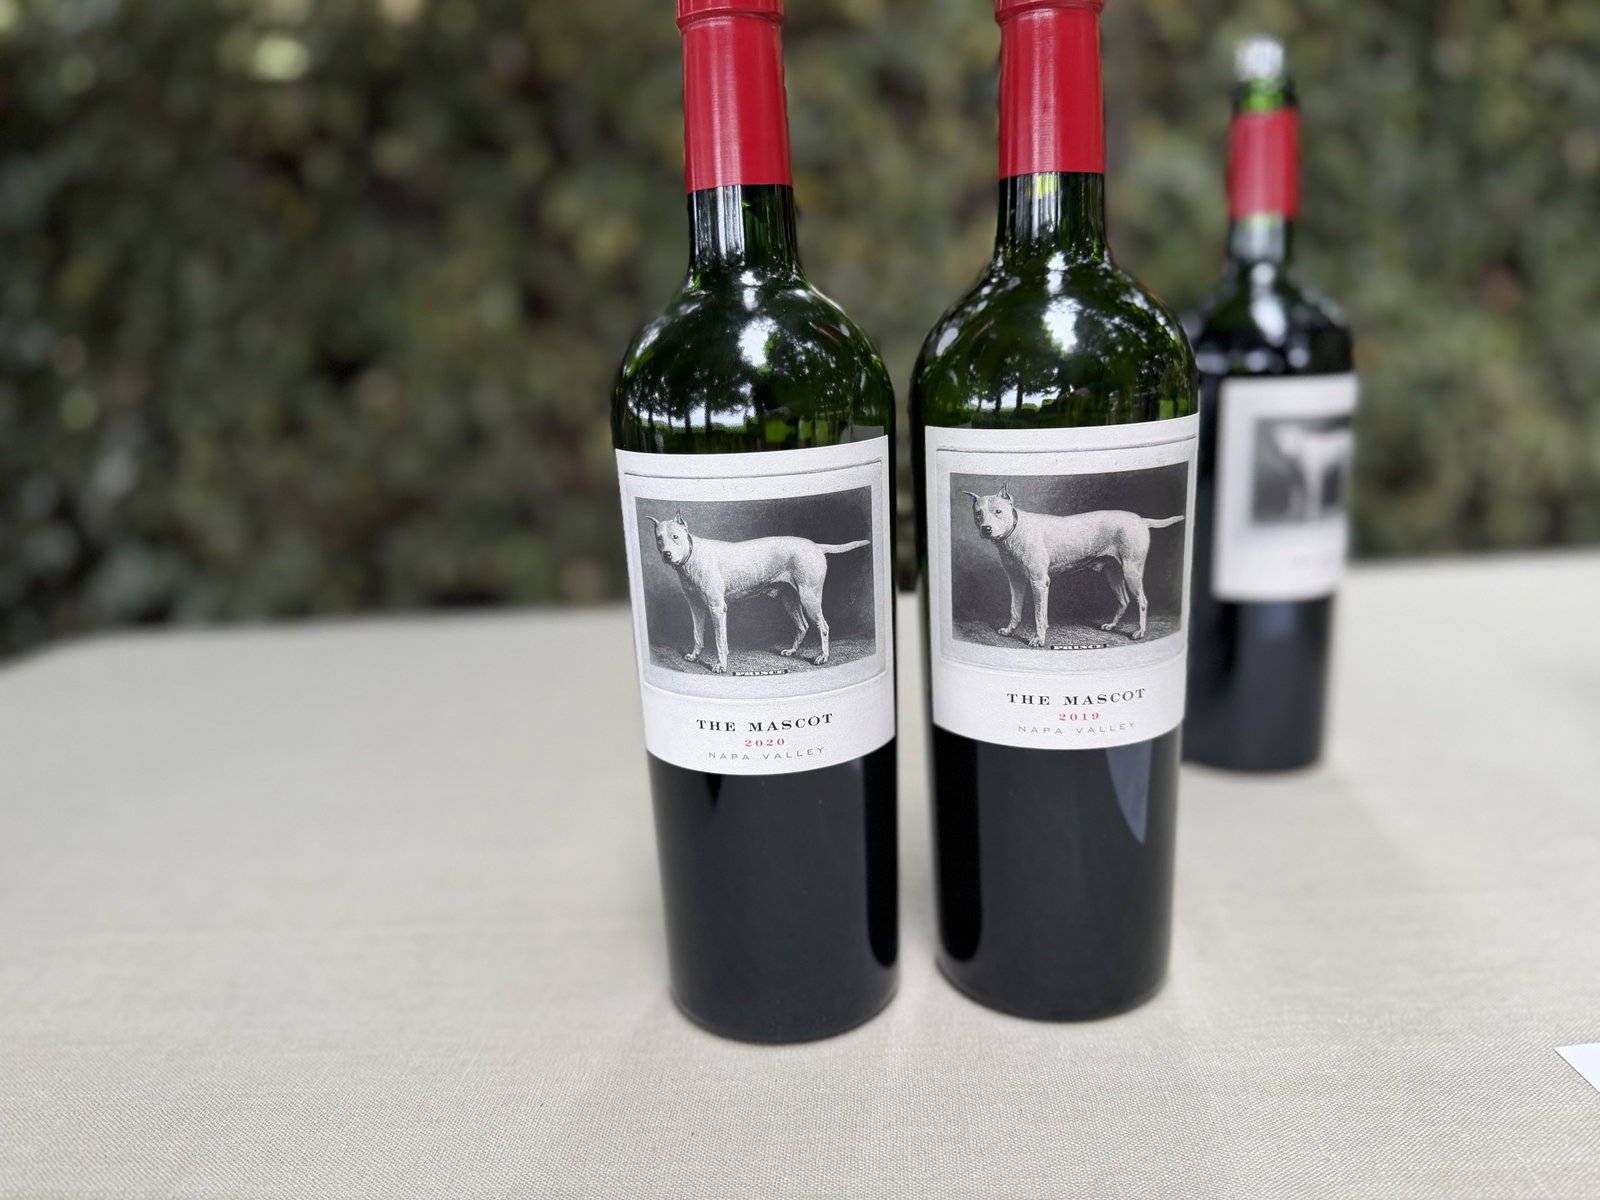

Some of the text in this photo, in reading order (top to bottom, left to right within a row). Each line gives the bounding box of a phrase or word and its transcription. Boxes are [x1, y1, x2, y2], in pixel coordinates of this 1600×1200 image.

[1006, 688, 1145, 706] THE MASCOT
[696, 713, 833, 732] THE MASCOT
[1058, 712, 1100, 721] 2019
[1018, 721, 1136, 735] NAPA VALLEY
[744, 737, 785, 748] 2020
[708, 746, 824, 761] NAPA VALLEY
